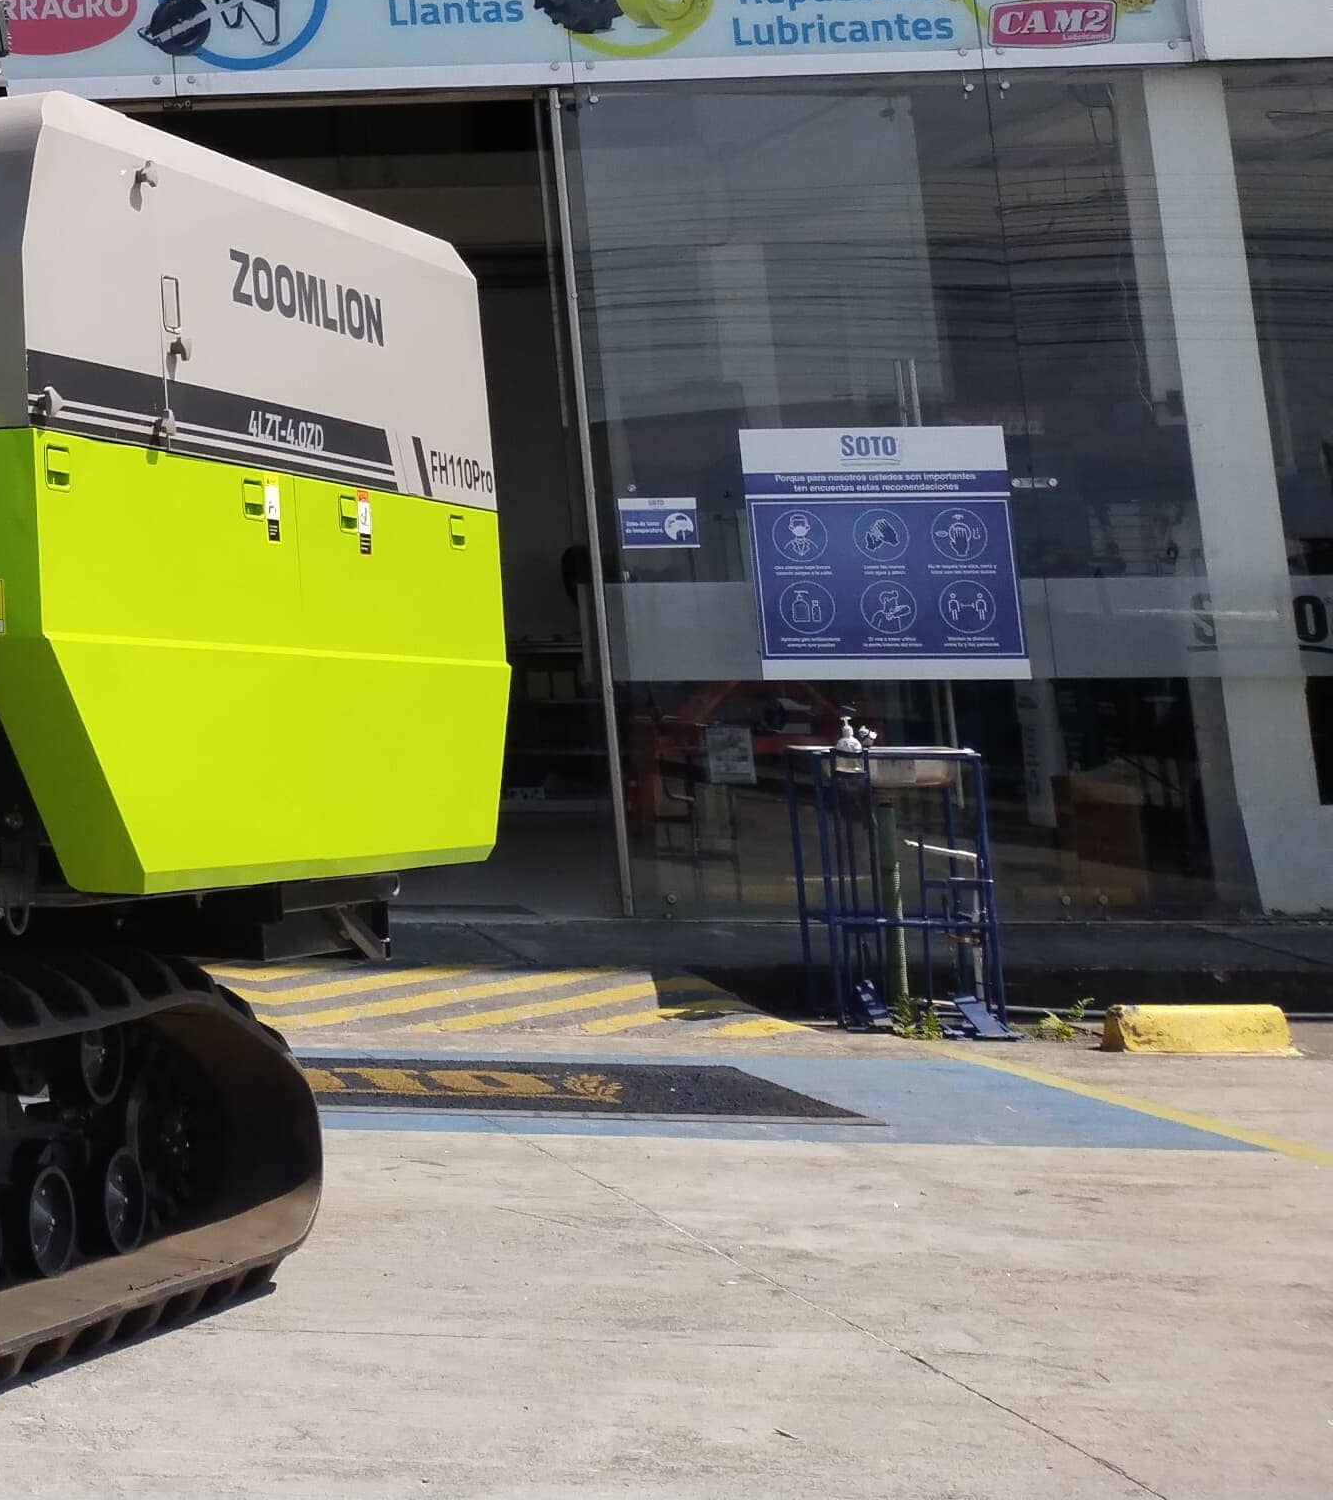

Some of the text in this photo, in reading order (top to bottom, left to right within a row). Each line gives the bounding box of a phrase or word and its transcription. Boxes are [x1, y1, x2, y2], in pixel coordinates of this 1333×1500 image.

[732, 10, 956, 47] Lubricantes
[998, 8, 1108, 35] CAM2
[229, 247, 385, 347] ZOOMLION
[248, 410, 324, 451] 4LZT-4.0ZD
[840, 434, 897, 457] SOTO
[430, 450, 494, 493] FH110Pro
